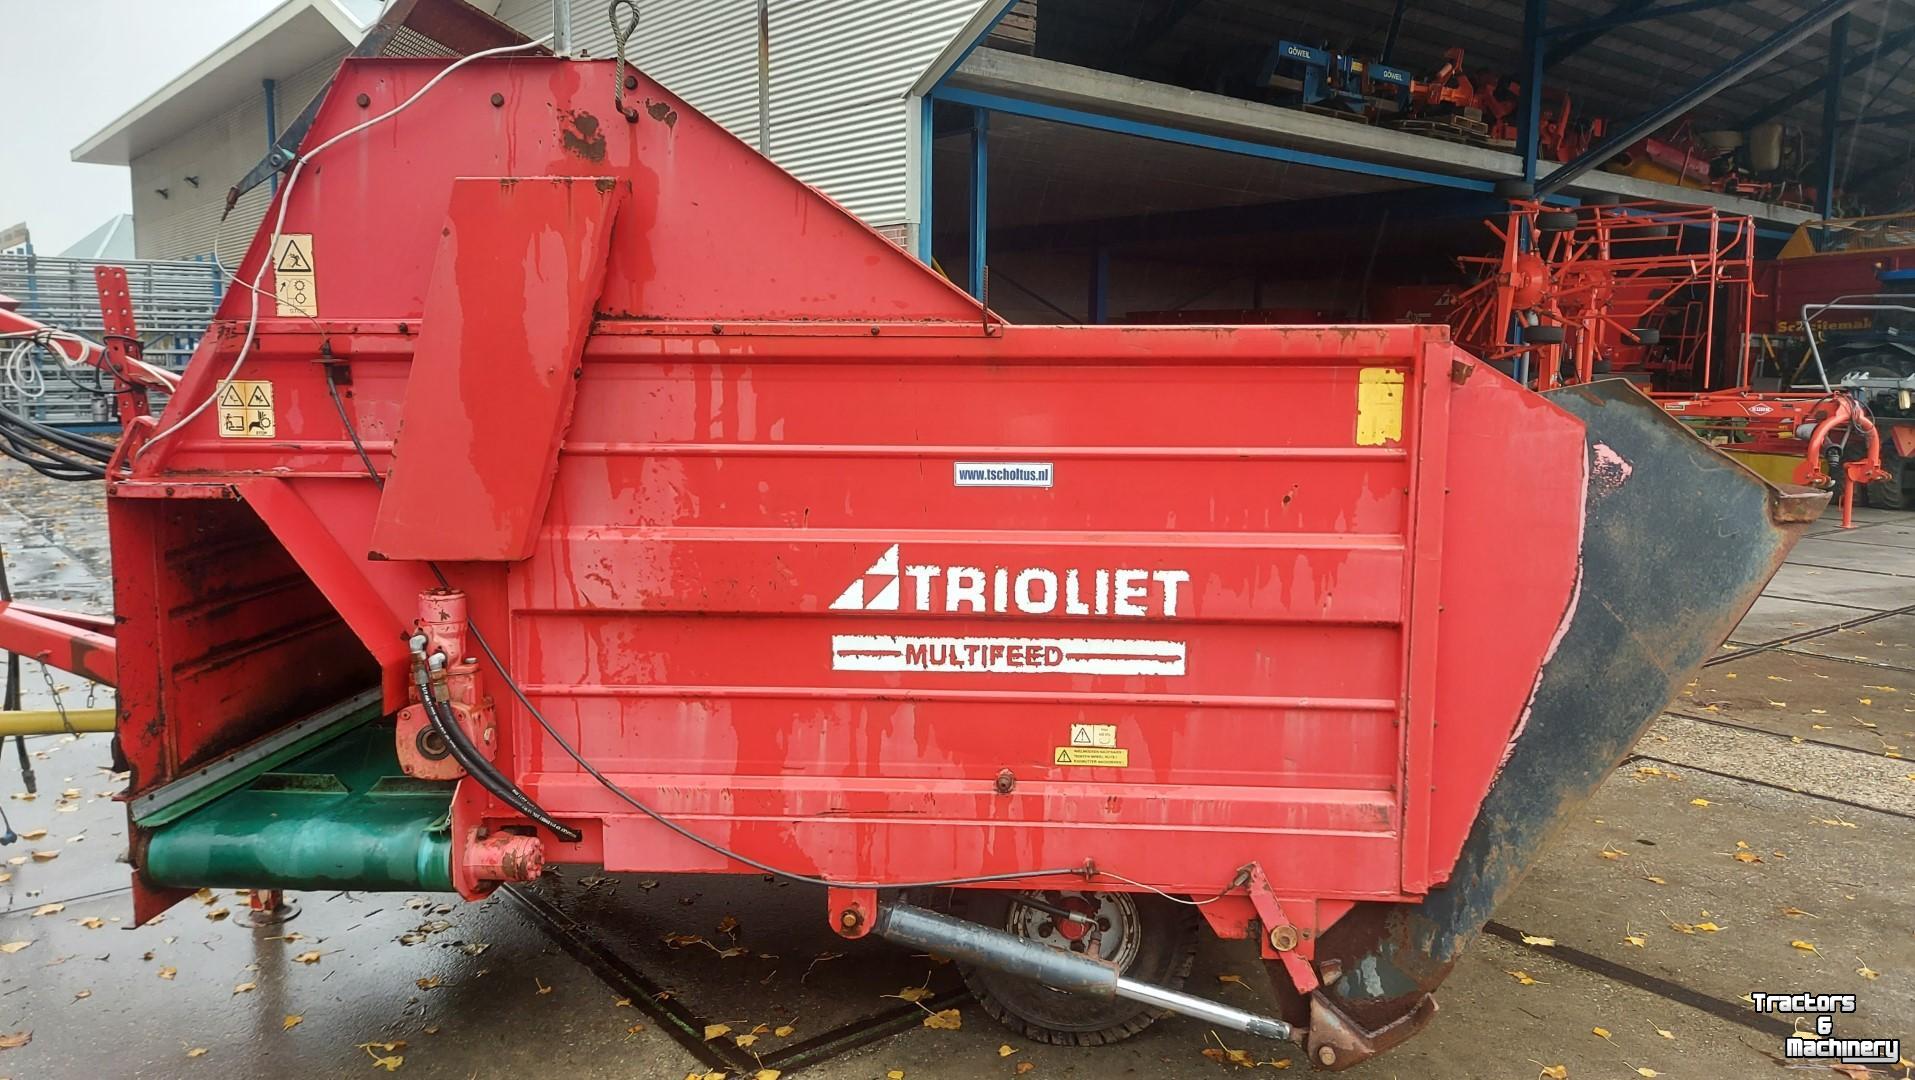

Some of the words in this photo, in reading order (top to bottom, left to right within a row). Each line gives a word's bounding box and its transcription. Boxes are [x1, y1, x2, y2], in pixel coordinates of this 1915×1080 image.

[959, 468, 1049, 481] www.tscholtus.nl
[904, 563, 1190, 617] TRIOLIET
[904, 643, 1064, 667] MULTIFEED
